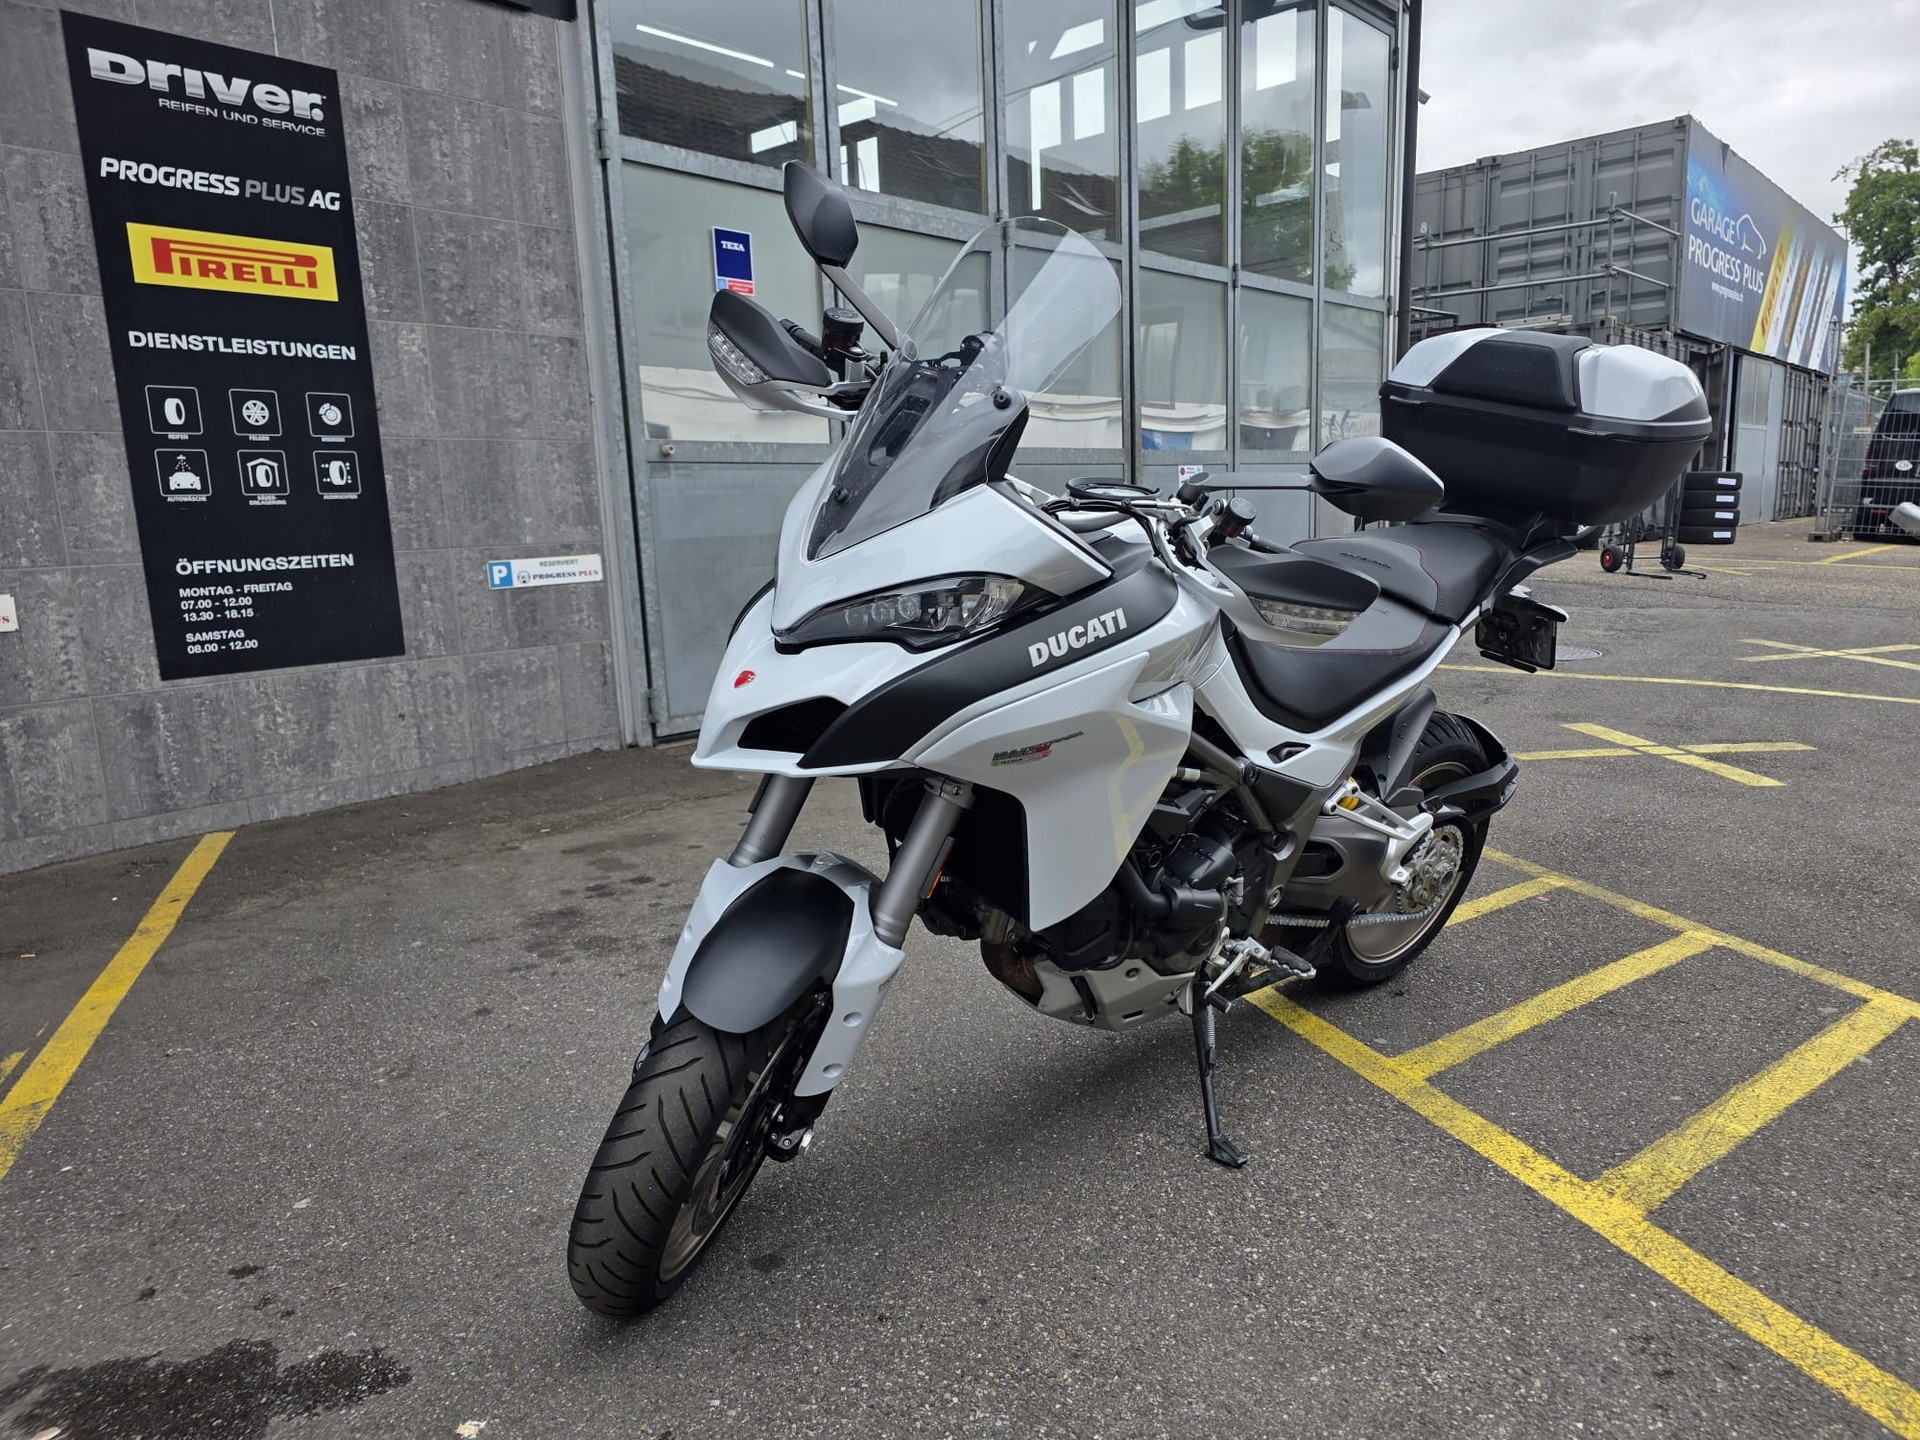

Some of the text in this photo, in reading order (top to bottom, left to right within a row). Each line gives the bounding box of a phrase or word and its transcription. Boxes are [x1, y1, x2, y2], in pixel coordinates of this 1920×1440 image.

[158, 98, 326, 137] REIFEN UND SERVICE
[100, 157, 341, 211] PROGRESS PLUS AG
[1691, 197, 1736, 245] GARAGE
[720, 240, 745, 252] TEXA
[150, 237, 318, 289] PIRELLI
[1688, 234, 1764, 294] PROGRESS PLUS
[128, 330, 357, 361] DIENSTLEISTUNGEN
[175, 553, 355, 576] ÖFFNUNGSZEITEN
[539, 559, 579, 567] RESERVIERT
[492, 565, 508, 585] P
[532, 571, 577, 580] PROGRESS
[179, 585, 234, 598] MONTAG
[243, 581, 293, 594] FREITAG
[181, 599, 212, 610] 07.00
[222, 596, 253, 607] 12.00
[183, 611, 214, 622] 13.30
[224, 608, 254, 619] 18.15
[185, 629, 245, 643] SAMSTAG
[1028, 607, 1128, 667] DUCATI
[187, 643, 219, 654] 08.00
[228, 639, 259, 650] 12.00
